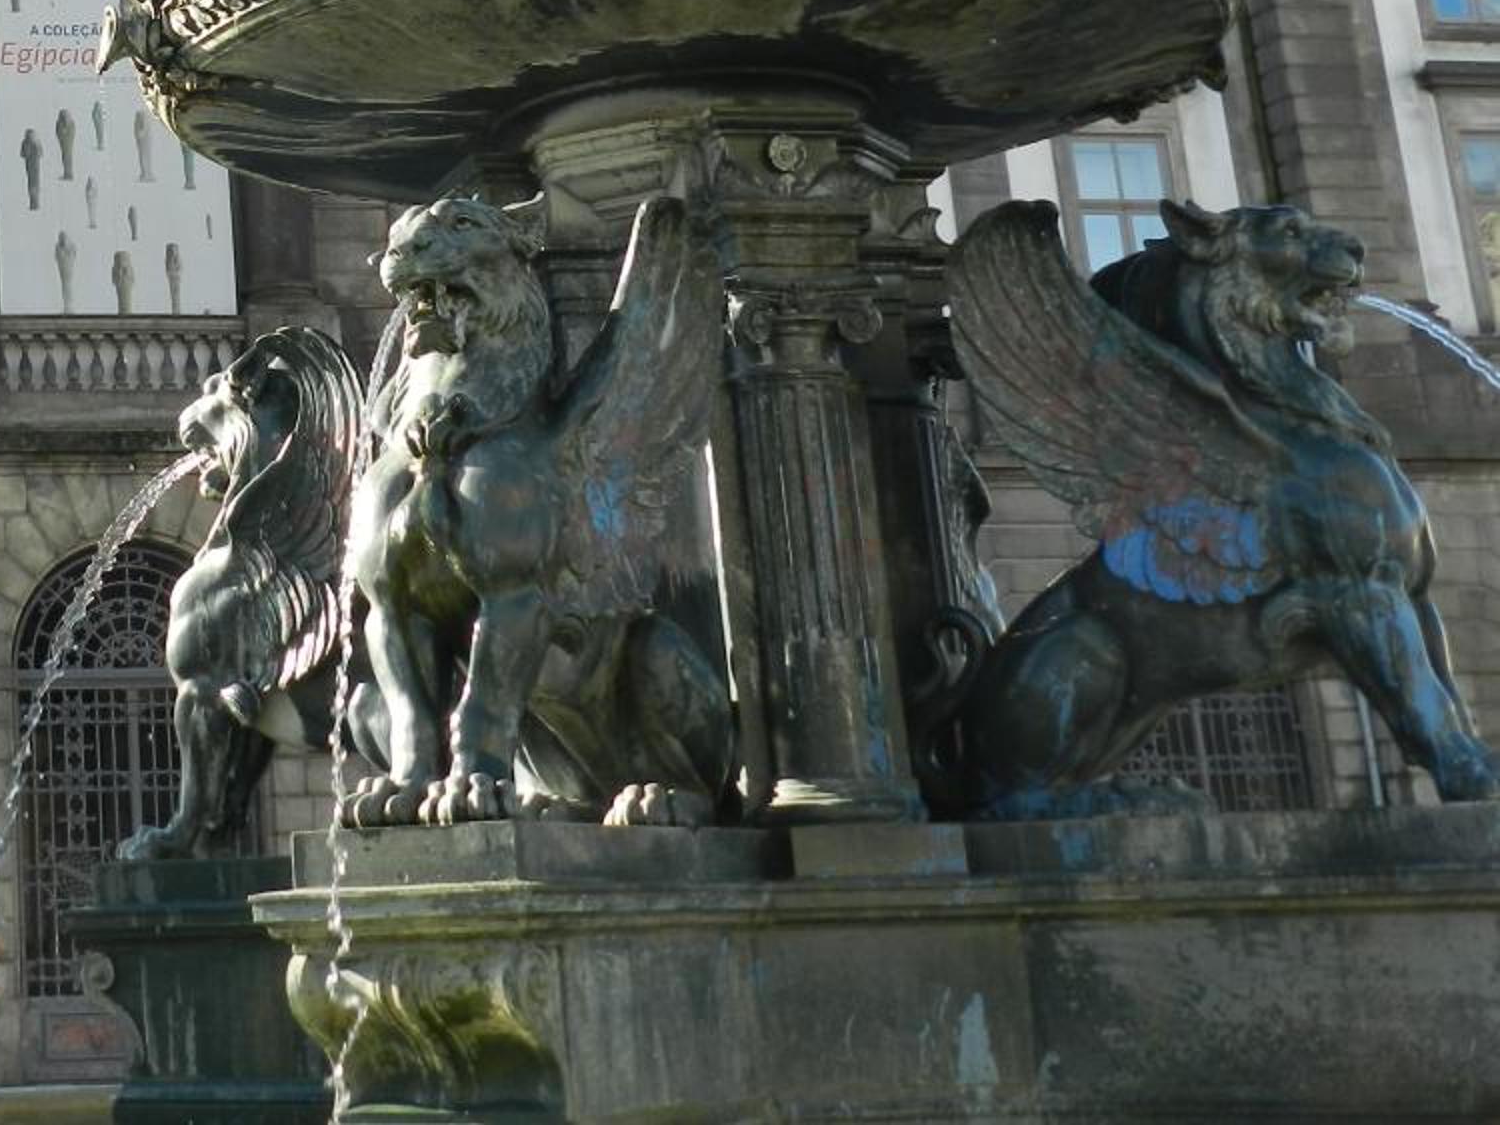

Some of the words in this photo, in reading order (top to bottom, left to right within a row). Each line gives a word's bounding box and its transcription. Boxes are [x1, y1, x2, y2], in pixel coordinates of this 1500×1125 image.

[30, 24, 39, 36] A
[43, 22, 102, 38] COLEÇÃ
[1, 41, 97, 74] Egípcia
